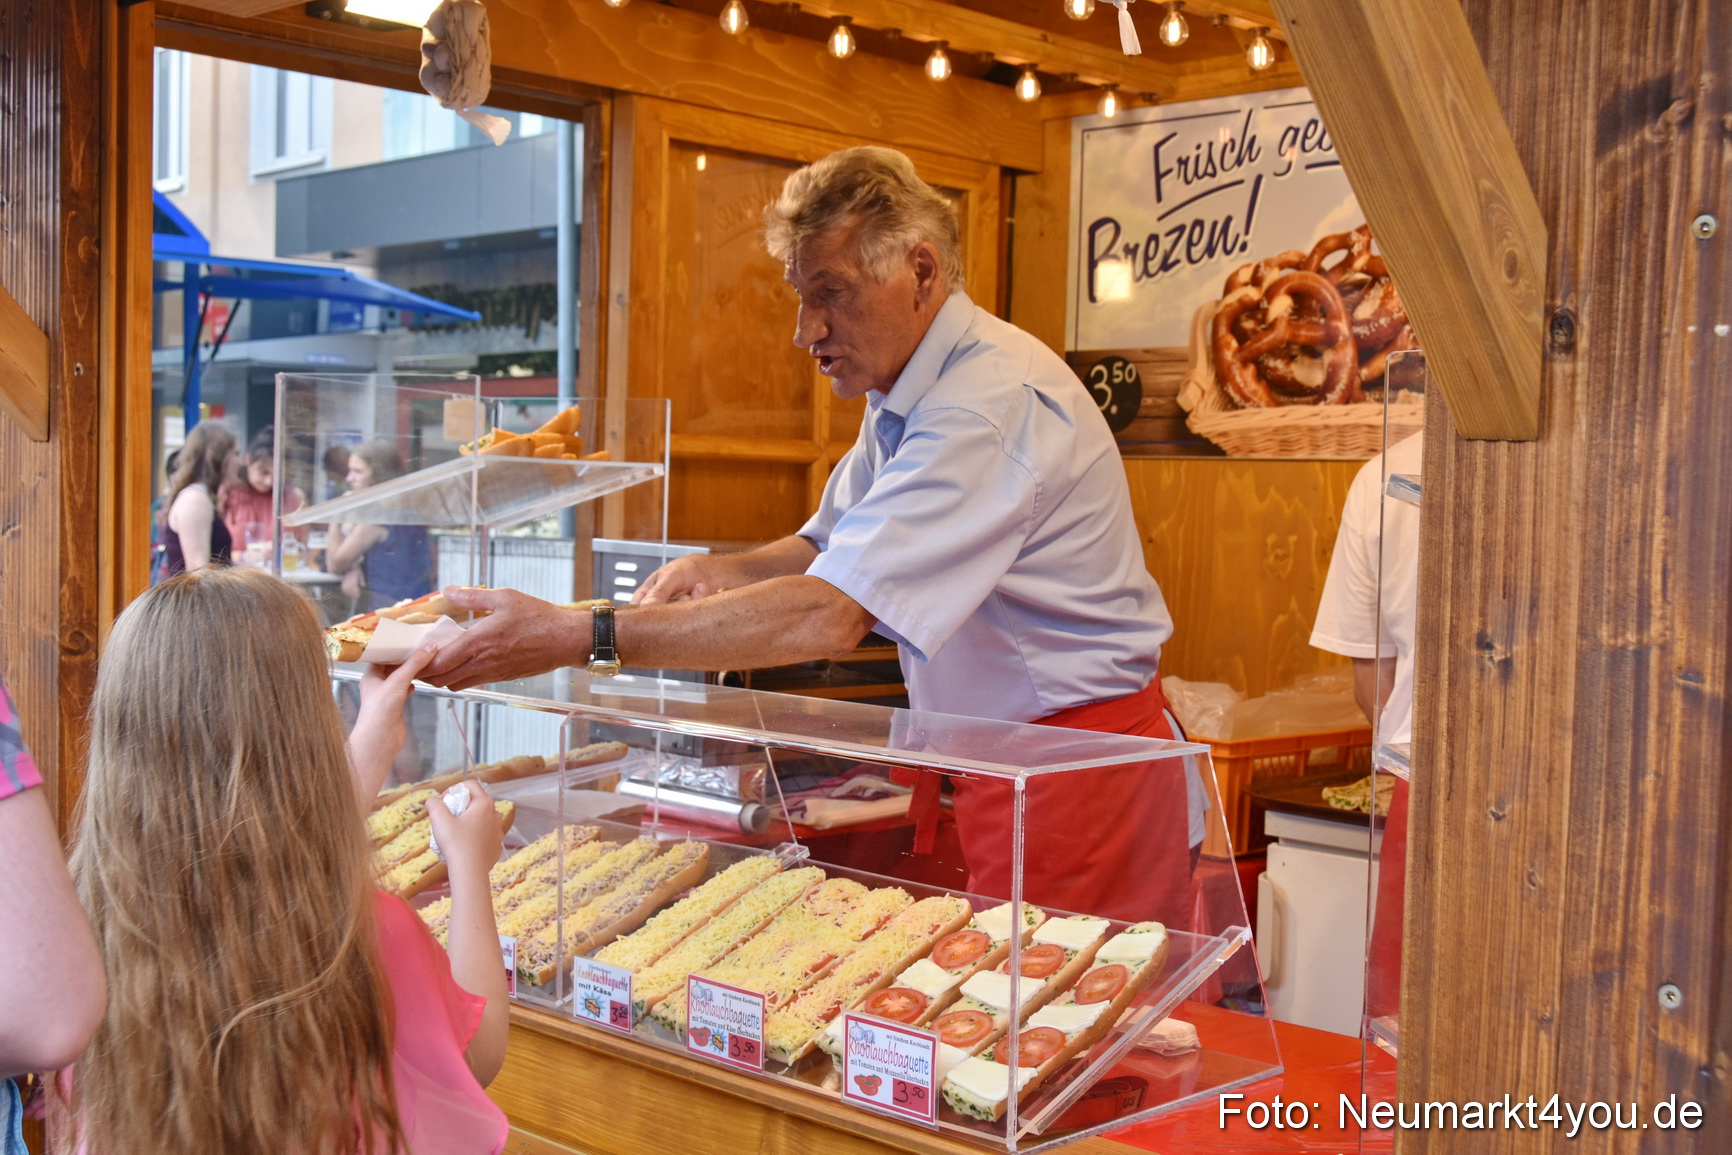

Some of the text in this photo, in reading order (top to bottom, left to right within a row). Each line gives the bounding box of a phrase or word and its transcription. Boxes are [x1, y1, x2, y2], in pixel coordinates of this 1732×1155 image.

[1154, 108, 1261, 203] Frisch
[1087, 174, 1263, 304] Brezen!
[578, 982, 612, 997] mit Käse
[690, 994, 760, 1031] Knoblauchbaguette
[700, 1016, 717, 1028] Tomaten
[717, 1022, 726, 1030] und
[726, 1023, 736, 1034] Käse
[737, 1027, 760, 1040] überbacken
[848, 1035, 930, 1076] Knoblauchbaguette
[850, 1058, 929, 1087] mit Tomaten und Mozzarella überbacken
